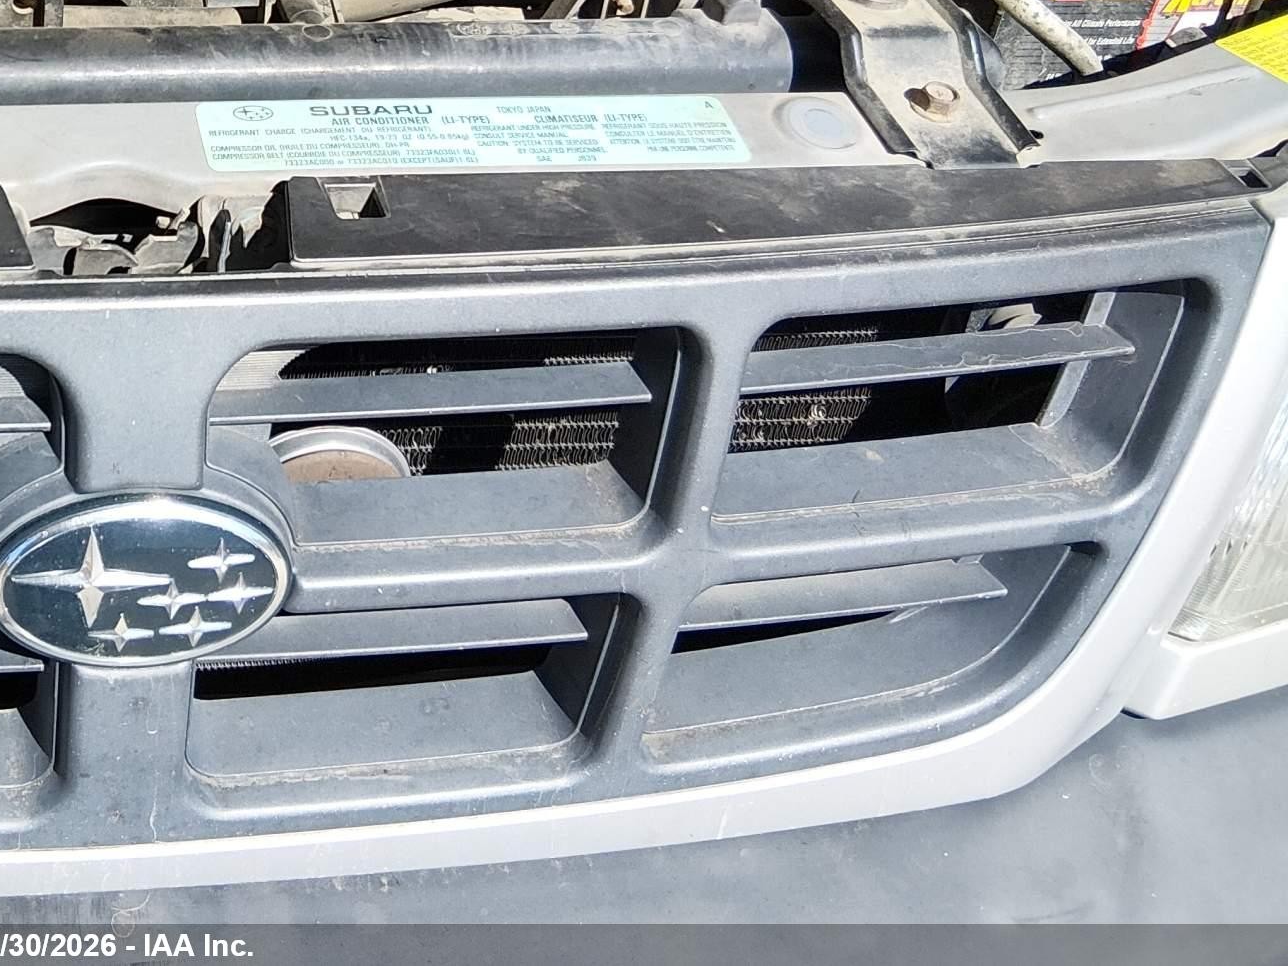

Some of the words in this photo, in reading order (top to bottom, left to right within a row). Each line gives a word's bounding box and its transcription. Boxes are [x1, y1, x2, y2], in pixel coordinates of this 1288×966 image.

[496, 106, 523, 114] TOKYO
[526, 105, 552, 113] JAPAN
[705, 101, 714, 109] A
[309, 105, 433, 116] SUBARU
[331, 118, 351, 126] AIR
[355, 116, 429, 125] CONDITIONER
[534, 114, 599, 123] CLIMATISEUR
